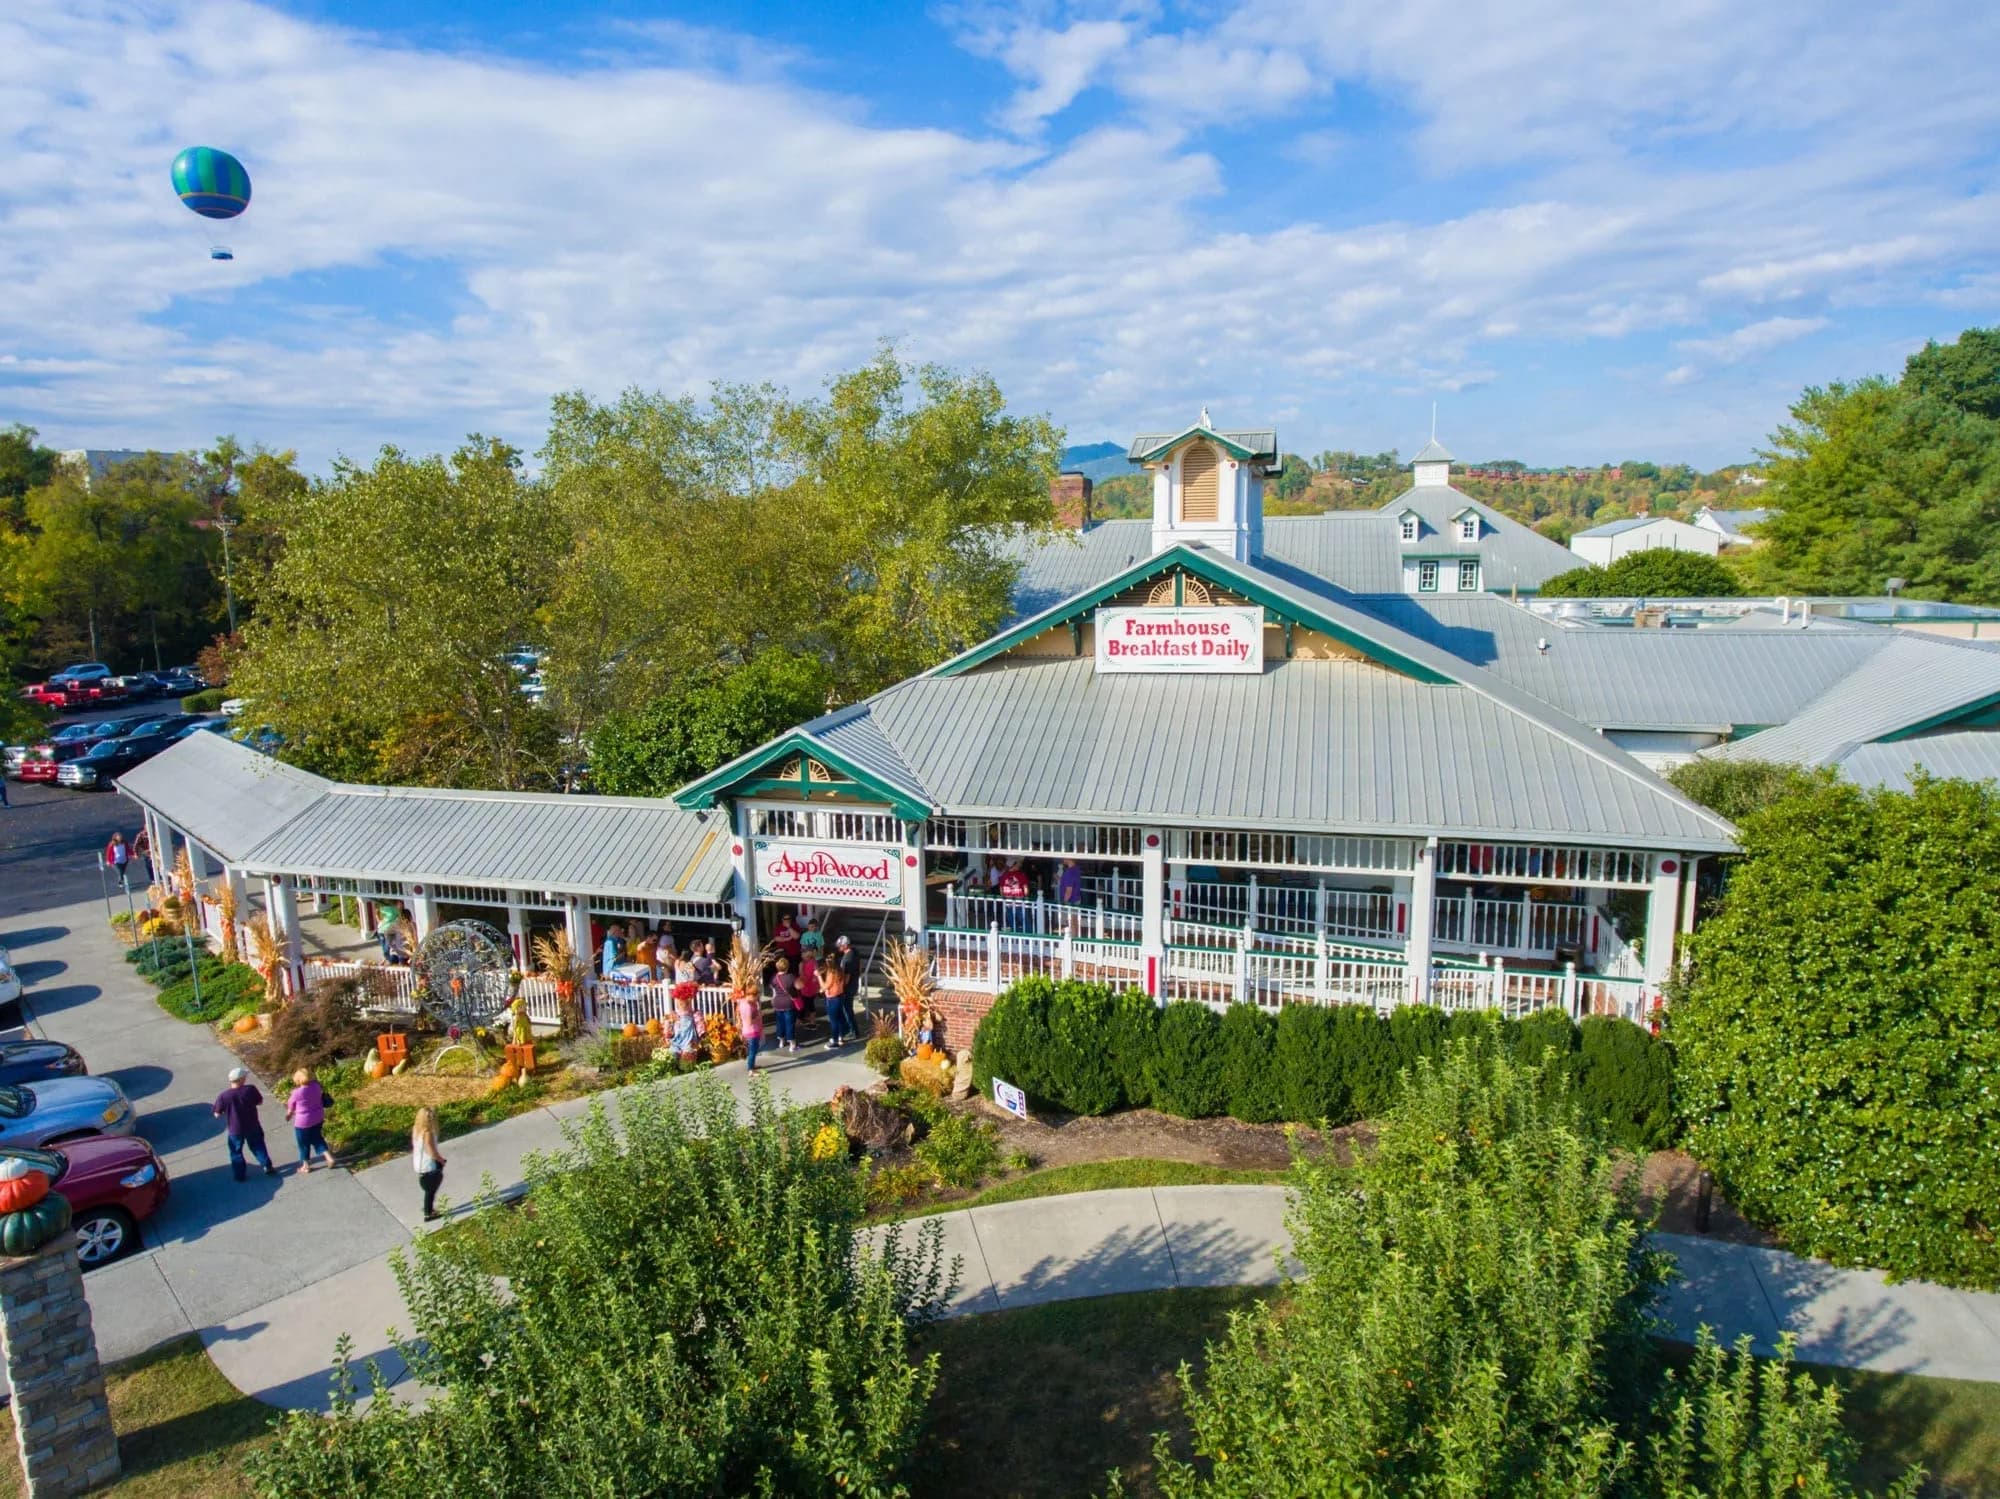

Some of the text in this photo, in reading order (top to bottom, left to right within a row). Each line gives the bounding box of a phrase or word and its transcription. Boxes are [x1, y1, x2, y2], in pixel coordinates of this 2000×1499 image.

[1125, 619, 1231, 636] Farmhouse
[1108, 639, 1249, 661] Breakfast Daily
[767, 850, 889, 882] Applewood
[815, 877, 890, 889] FARMHOUSE GRILL
